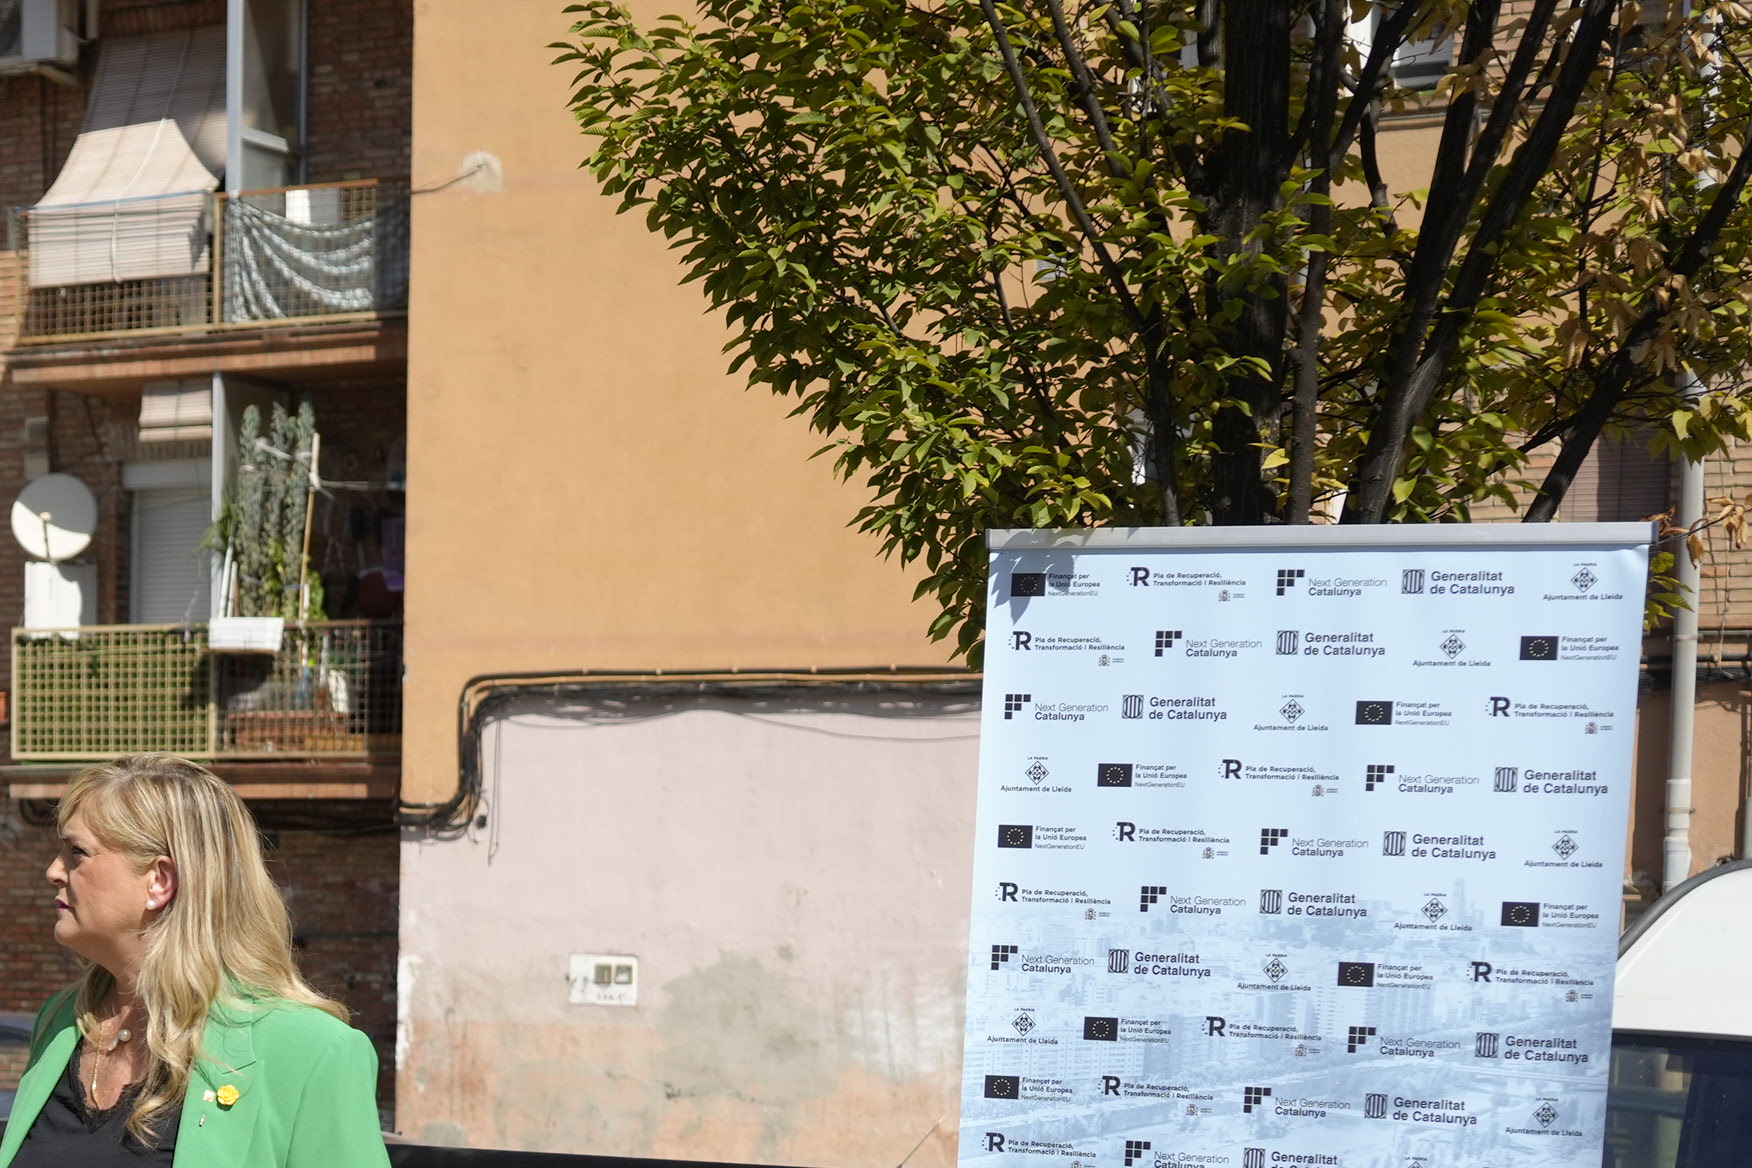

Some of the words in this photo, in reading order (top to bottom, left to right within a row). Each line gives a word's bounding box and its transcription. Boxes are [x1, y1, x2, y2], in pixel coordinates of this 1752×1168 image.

[1308, 578, 1330, 587] Next
[1333, 577, 1387, 587] Generation
[1431, 571, 1502, 581] Generalitat
[1308, 585, 1361, 597] Catalunya
[1430, 584, 1445, 594] de
[1449, 583, 1514, 596] Catalunya
[1035, 703, 1055, 712] Next
[1058, 702, 1108, 712] Generation
[1149, 696, 1215, 707] Generalitat
[1035, 710, 1084, 722] Catalunya
[1148, 709, 1163, 719] de
[1167, 709, 1226, 721] Catalunya
[1524, 769, 1596, 780] Generalitat
[1523, 783, 1539, 793] de
[1543, 783, 1607, 796] Catalunya
[1292, 838, 1313, 847] Next
[1316, 838, 1368, 847] Generation
[1292, 845, 1343, 858] Catalunya
[1288, 892, 1355, 903] Generalitat
[1287, 905, 1302, 915] de
[1306, 905, 1366, 919] Catalunya
[1021, 954, 1043, 964] Next
[1044, 954, 1094, 965] Generation
[1134, 951, 1199, 963] Generalitat
[1021, 961, 1071, 974] Catalunya
[1134, 964, 1148, 974] de
[1152, 964, 1210, 979] Catalunya
[1521, 969, 1569, 977] Recuperació,
[1495, 976, 1549, 984] Transformació
[1120, 1018, 1148, 1026] Finançat
[1144, 1027, 1171, 1035] Europea
[987, 1035, 1026, 1043] Ajuntament
[1275, 1096, 1298, 1106] Next
[1299, 1096, 1350, 1109] Generation
[1393, 1096, 1464, 1110] Generalitat
[1275, 1104, 1326, 1118] Catalunya
[1392, 1110, 1408, 1120] de
[1412, 1110, 1476, 1126] Catalunya
[1271, 1151, 1337, 1165] Generalitat
